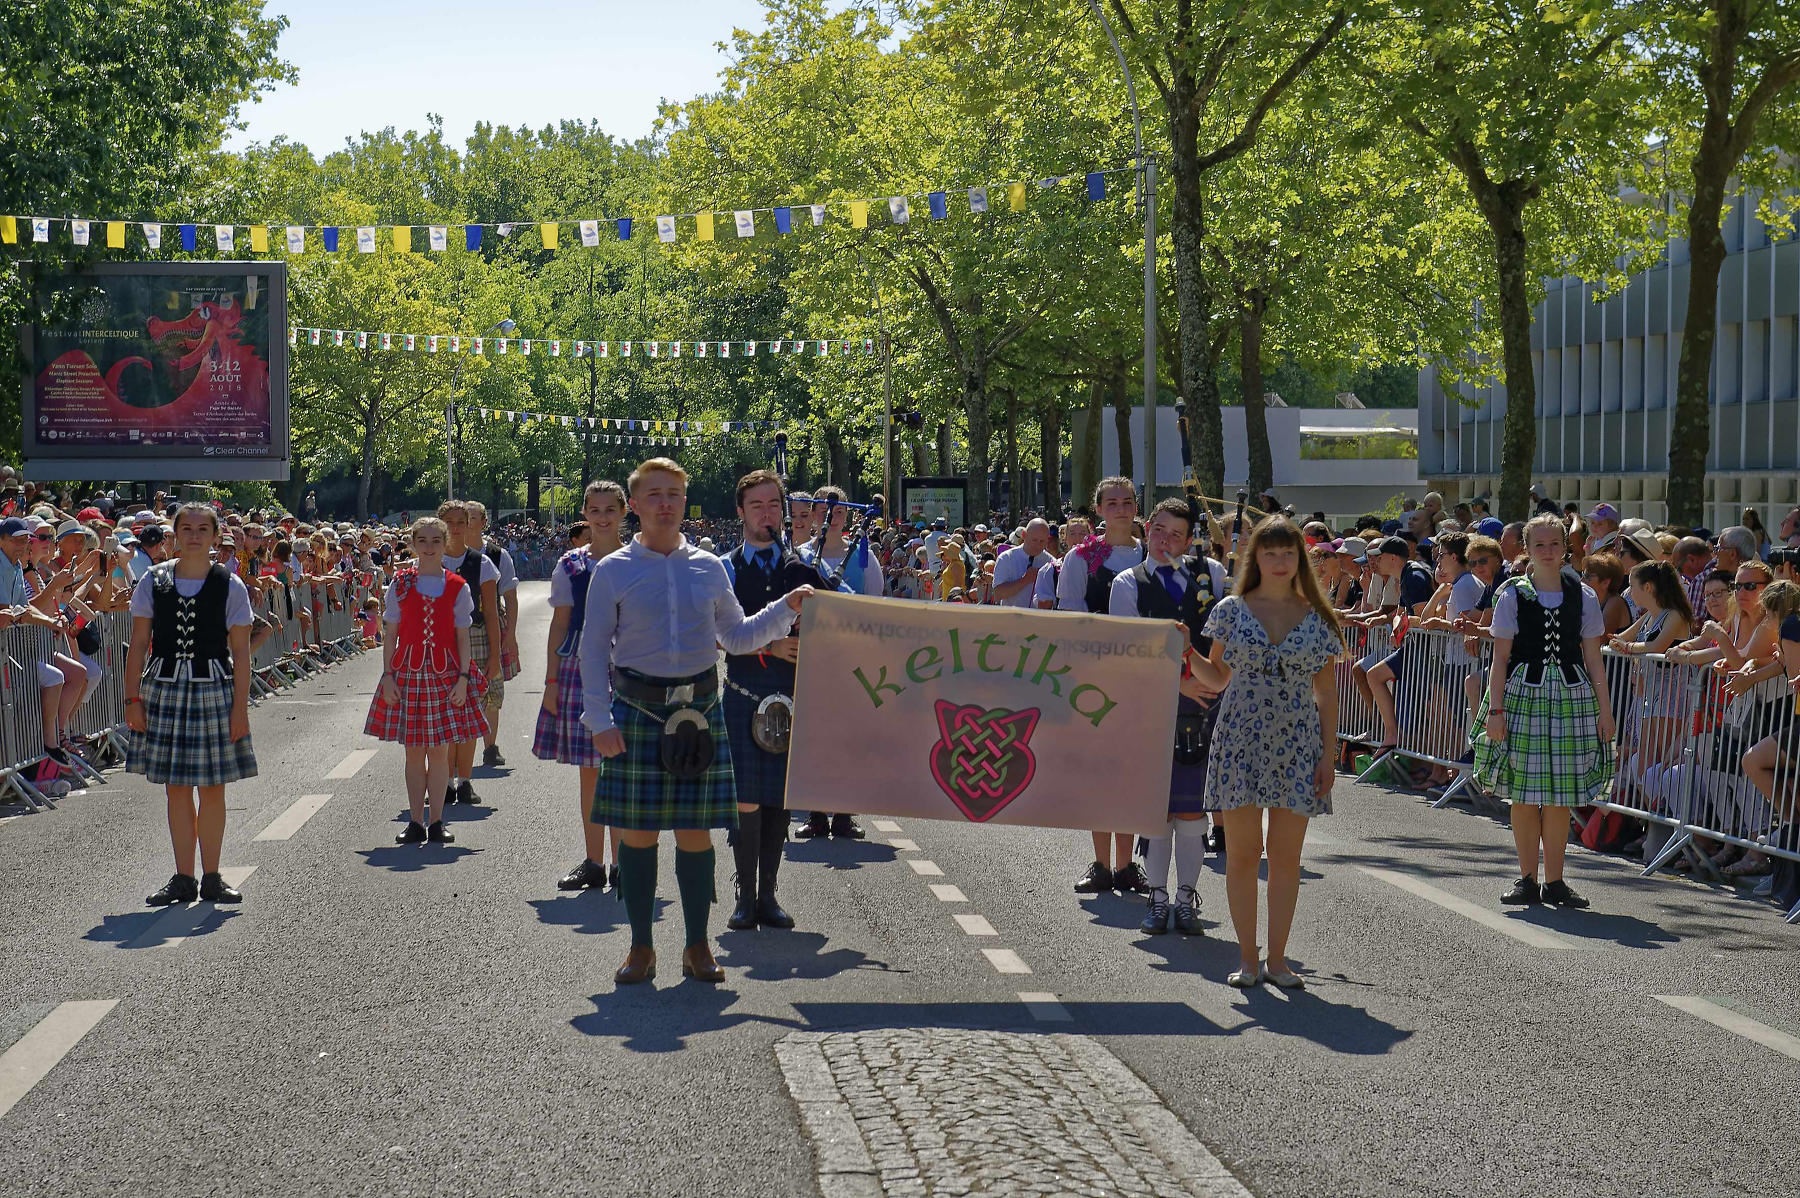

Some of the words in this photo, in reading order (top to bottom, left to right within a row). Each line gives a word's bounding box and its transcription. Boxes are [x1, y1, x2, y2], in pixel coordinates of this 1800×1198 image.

[41, 330, 82, 338] Festival
[82, 330, 139, 339] INTERCELTIQUE
[209, 360, 241, 372] 3-12
[209, 373, 242, 383] AOÛT
[215, 447, 236, 455] Clear
[236, 447, 269, 455] Channel
